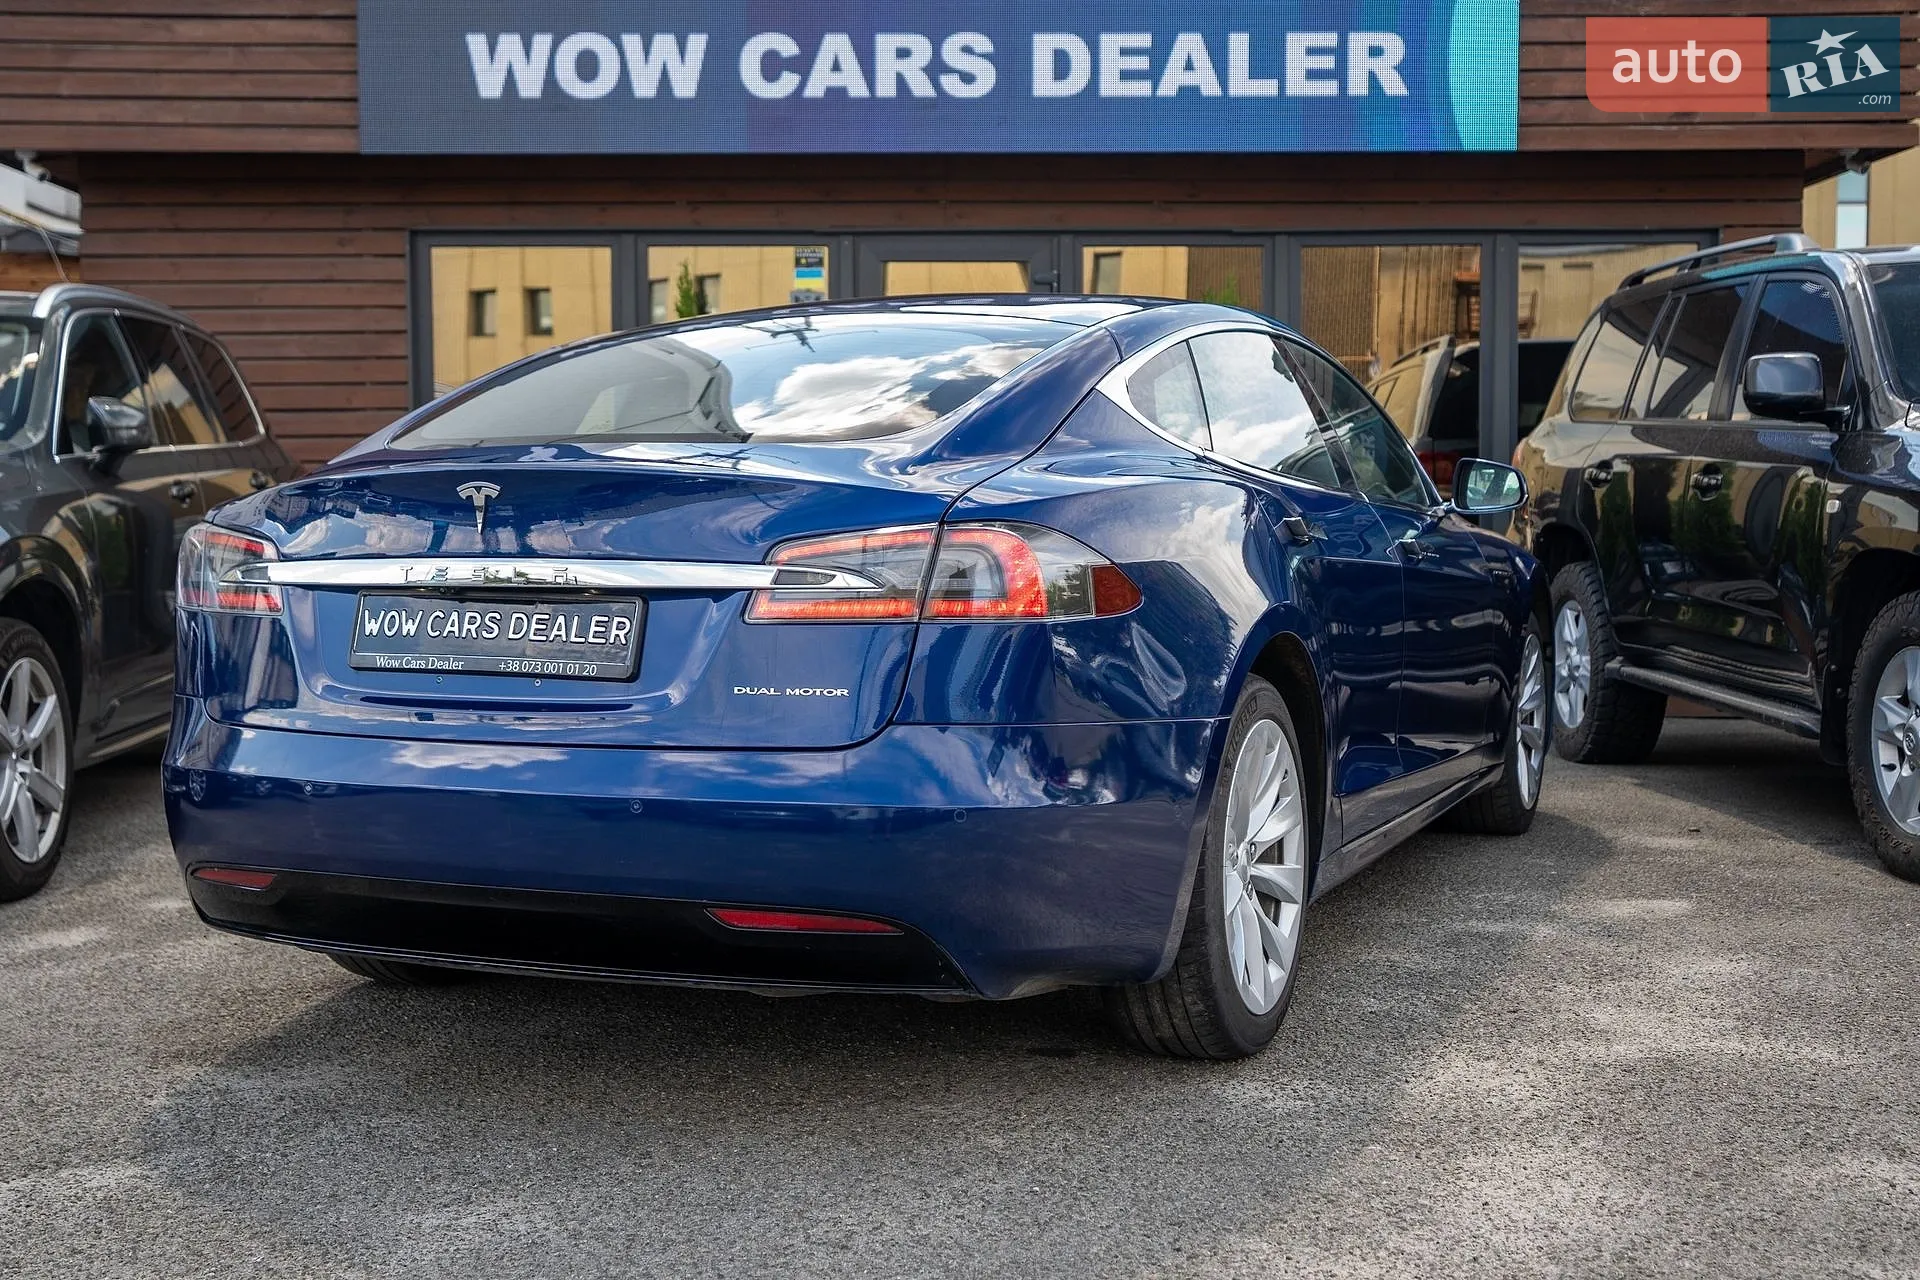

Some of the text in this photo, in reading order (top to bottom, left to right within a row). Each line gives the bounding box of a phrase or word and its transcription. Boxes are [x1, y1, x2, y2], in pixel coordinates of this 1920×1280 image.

[466, 31, 1408, 99] WOW CARS DEALER
[400, 566, 579, 586] TESLA
[363, 608, 632, 646] WOW CARS DEALER
[375, 656, 464, 671] Wow Cars Dealer
[499, 662, 597, 676] +38 073 001 01 20
[733, 686, 849, 697] DUAL MOTOR
